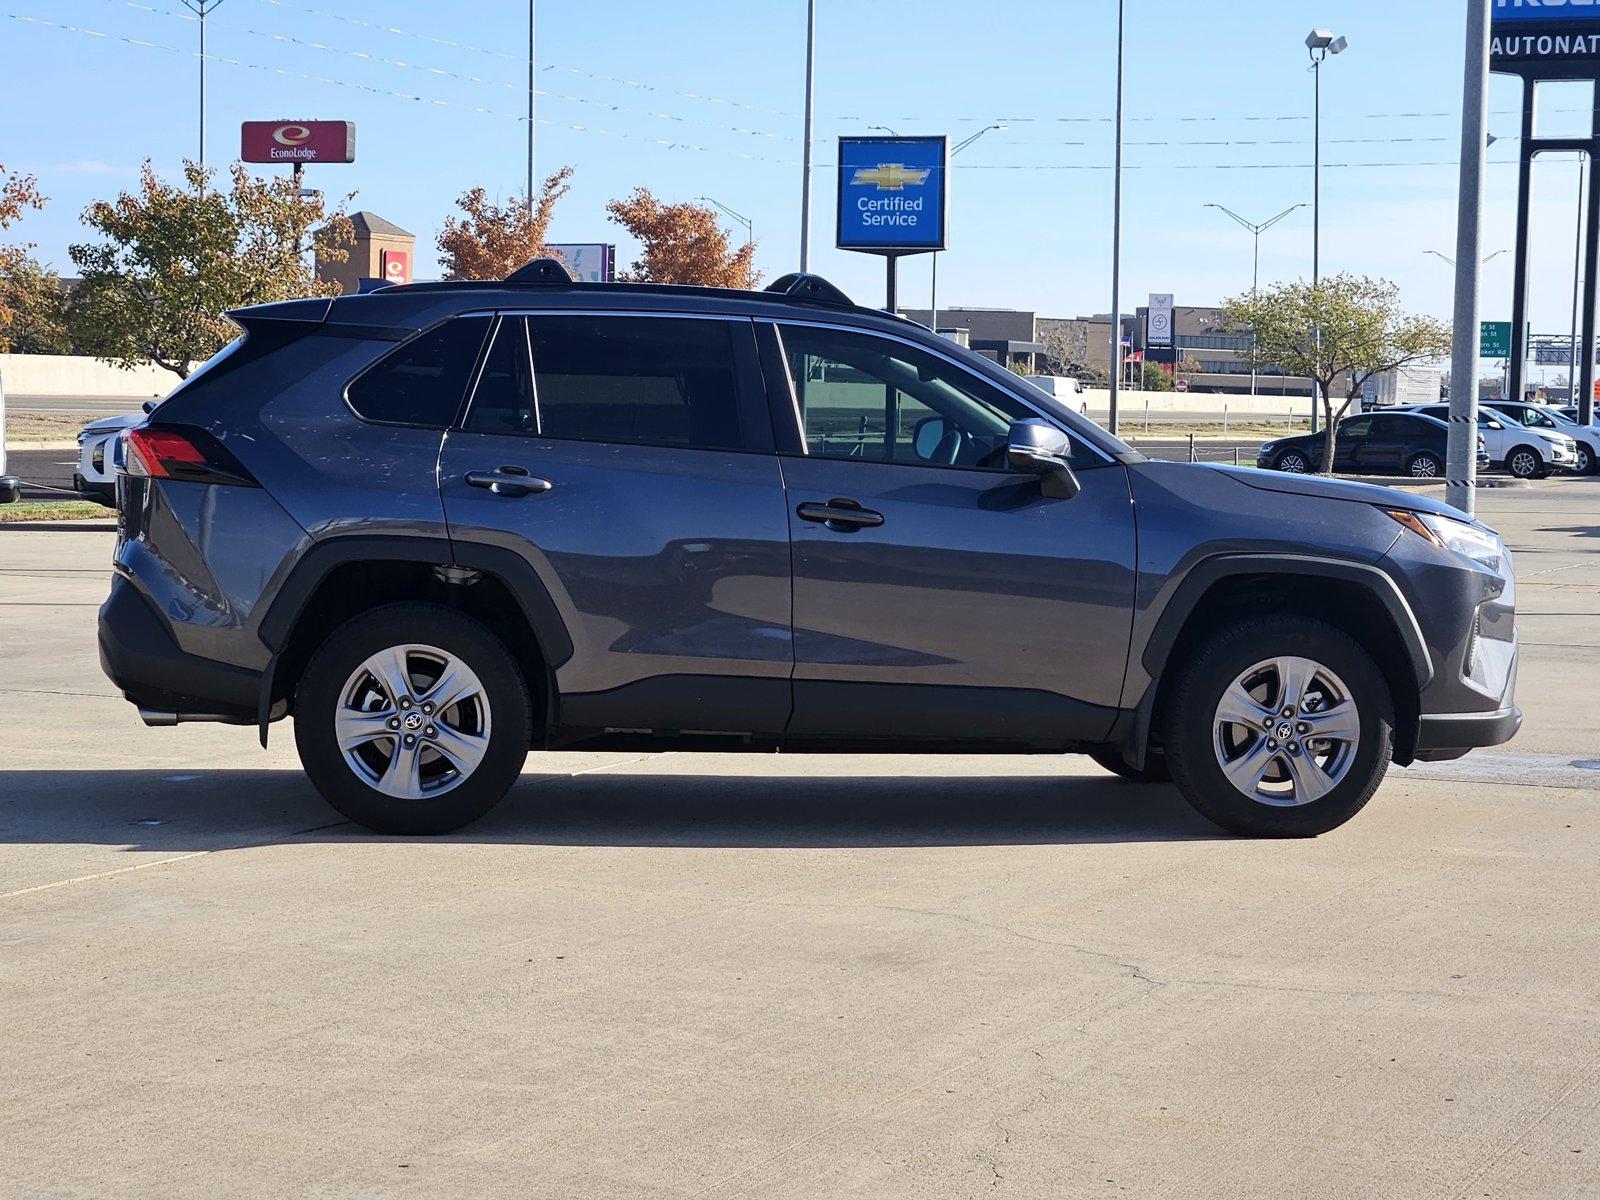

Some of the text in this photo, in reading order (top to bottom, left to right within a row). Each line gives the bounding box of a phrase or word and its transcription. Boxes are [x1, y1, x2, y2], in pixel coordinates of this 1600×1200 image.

[1490, 35, 1600, 55] AUTONAT
[270, 147, 316, 159] EconoLodge
[857, 197, 923, 211] Certified
[862, 212, 917, 226] Service
